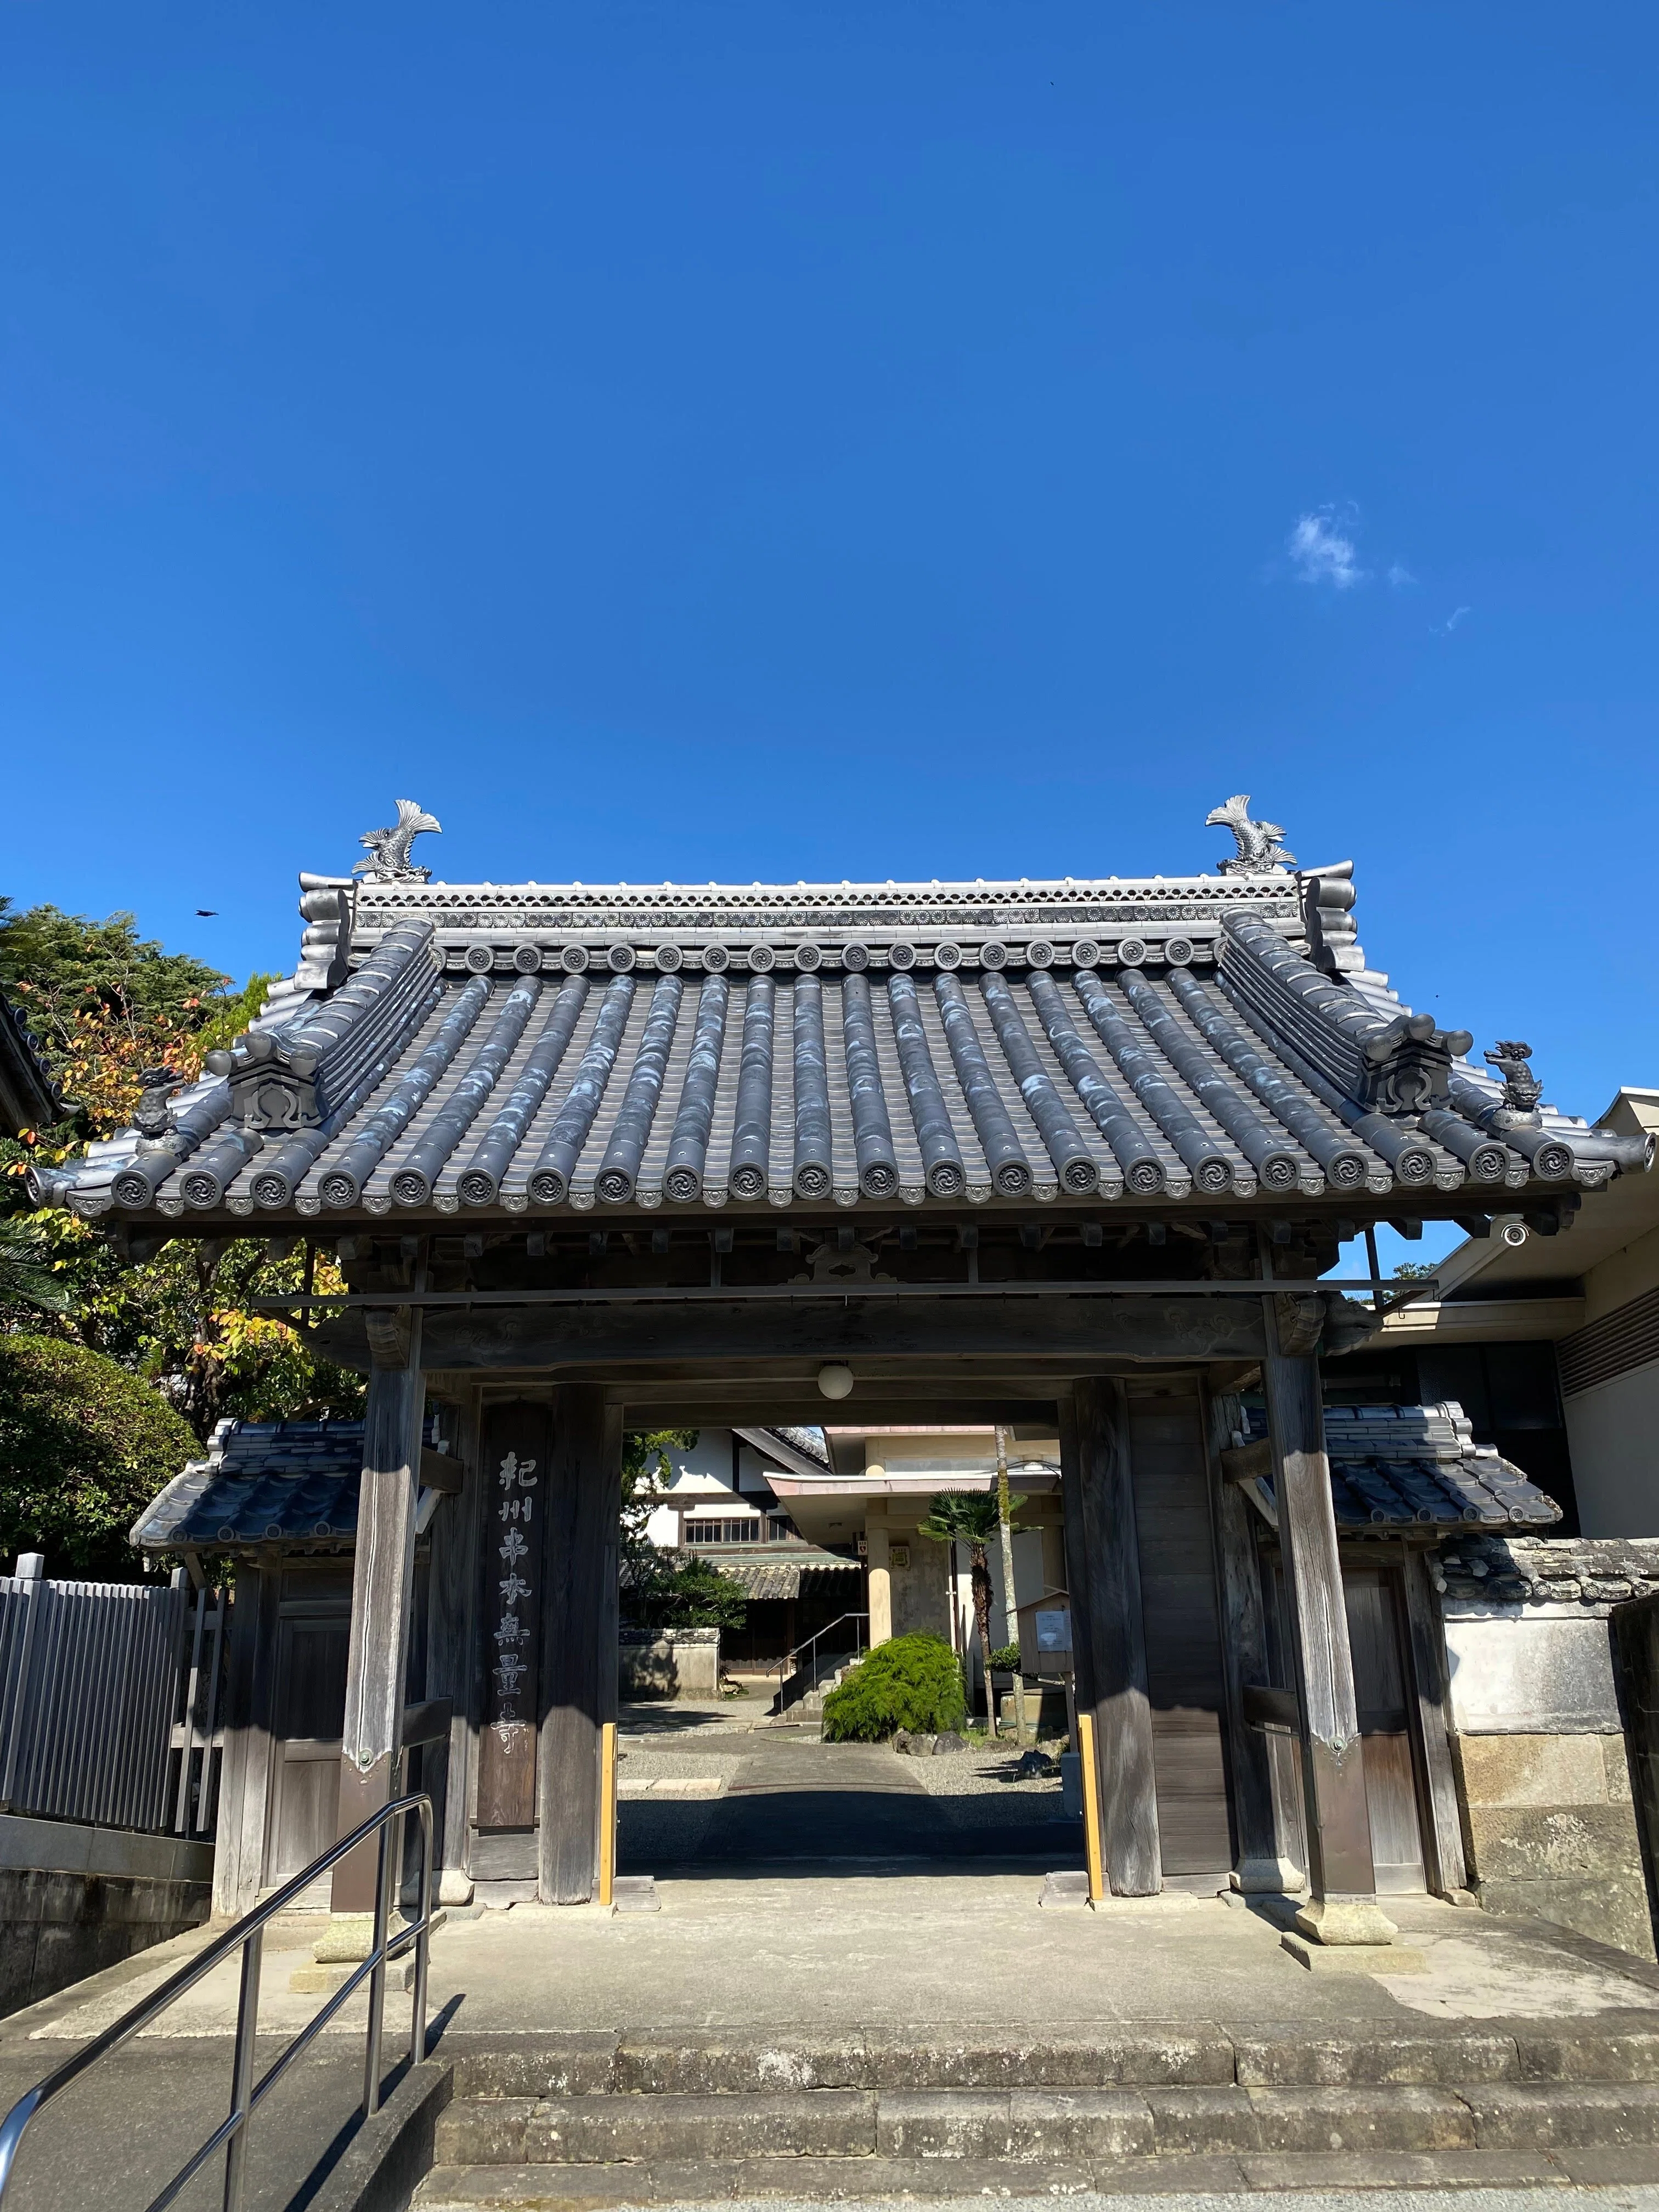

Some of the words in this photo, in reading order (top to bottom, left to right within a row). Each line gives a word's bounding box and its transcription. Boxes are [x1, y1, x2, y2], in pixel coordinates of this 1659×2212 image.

[490, 1451, 538, 1754] 紀州串本無量寺
